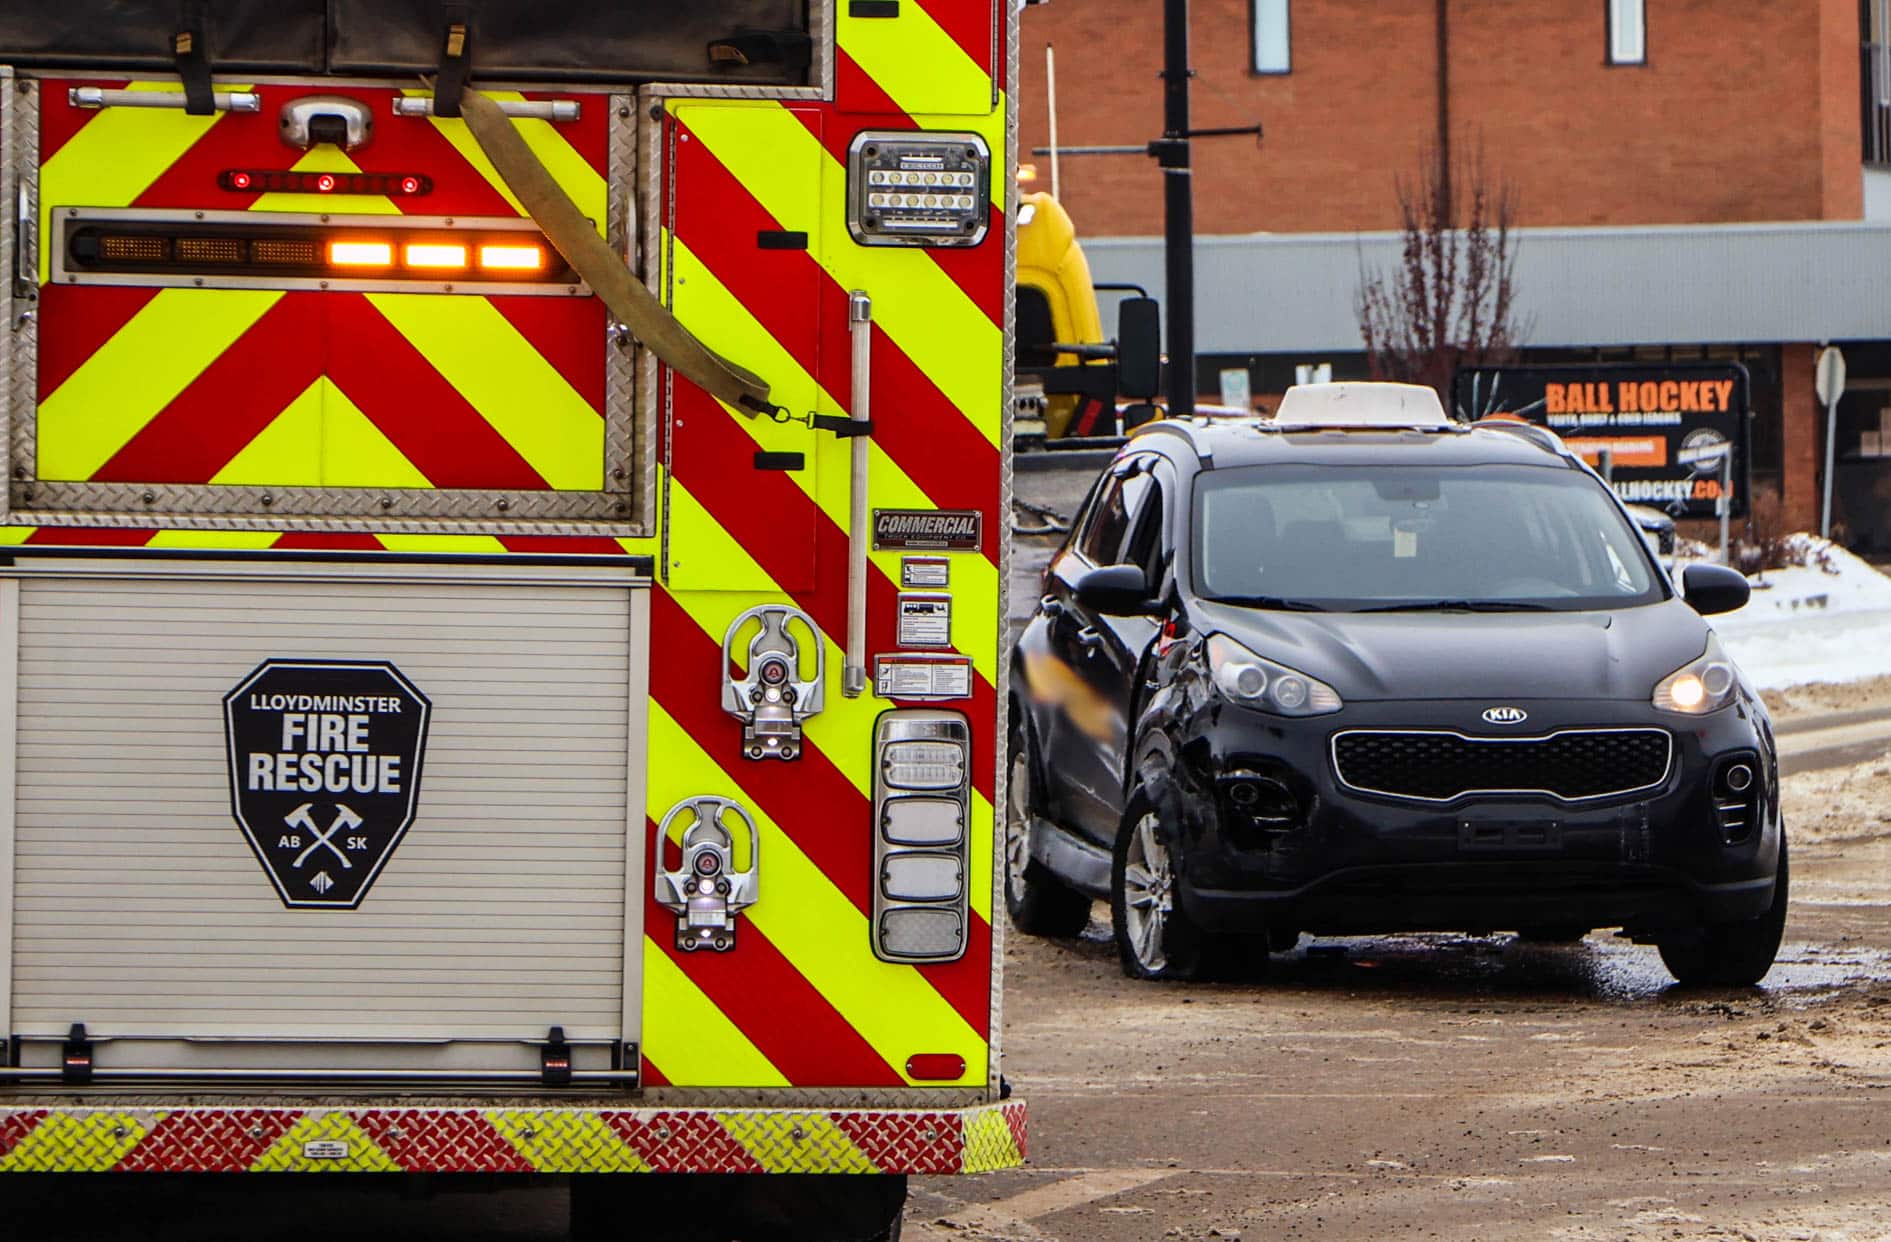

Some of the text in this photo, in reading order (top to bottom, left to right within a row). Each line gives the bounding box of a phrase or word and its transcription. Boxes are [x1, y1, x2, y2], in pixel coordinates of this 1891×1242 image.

[1545, 380, 1733, 413] BALL HOCKEY
[877, 515, 975, 534] COMMERCIAL
[251, 694, 401, 712] LLOYDMINSTER
[1490, 708, 1520, 720] KIA
[282, 713, 369, 752] FIRE
[248, 753, 400, 793] RESCUE
[278, 835, 367, 849] AB SK
